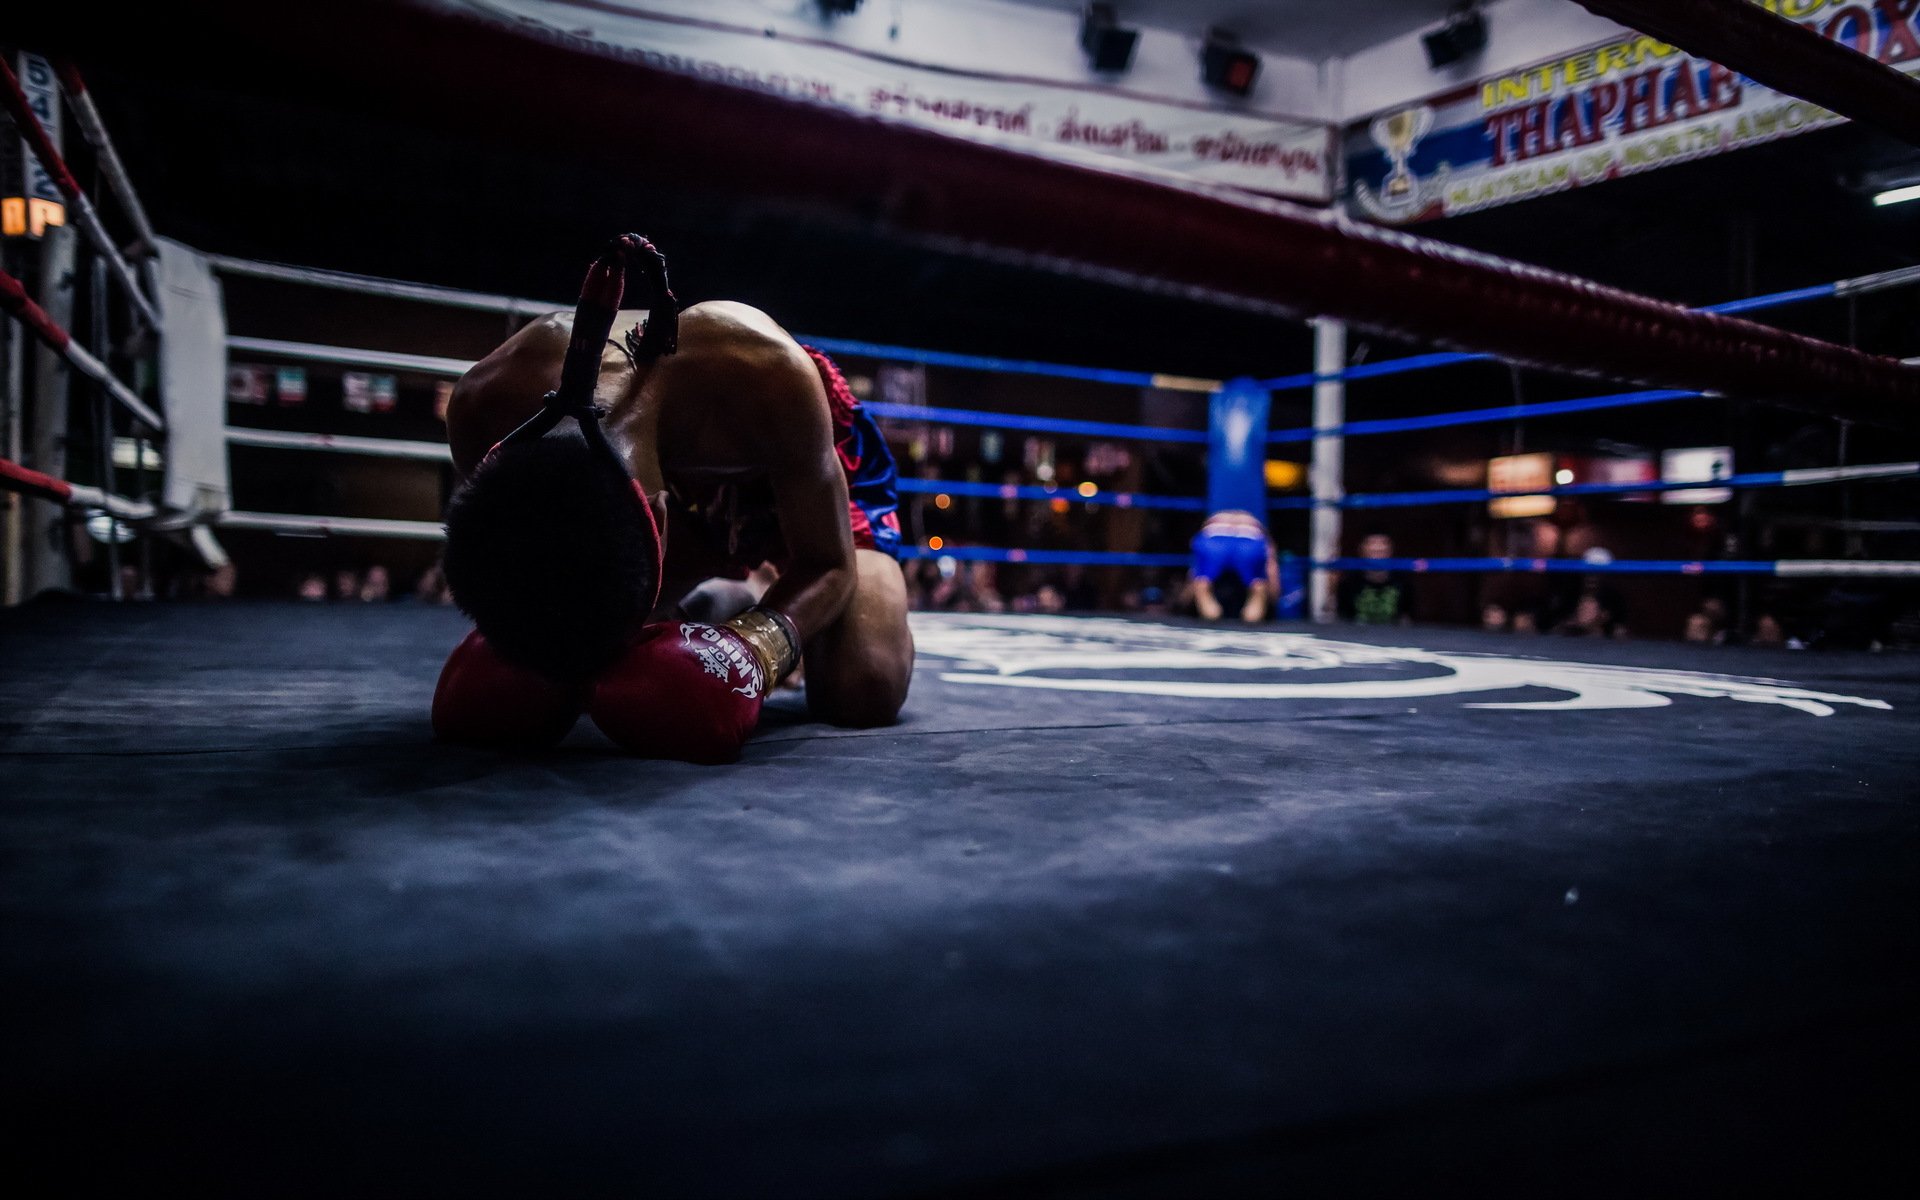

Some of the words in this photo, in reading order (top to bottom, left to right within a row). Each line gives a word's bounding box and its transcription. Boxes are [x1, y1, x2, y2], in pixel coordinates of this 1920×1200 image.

[1482, 35, 1682, 107] INTERN
[701, 628, 754, 679] KING
[708, 645, 730, 669] TOP
